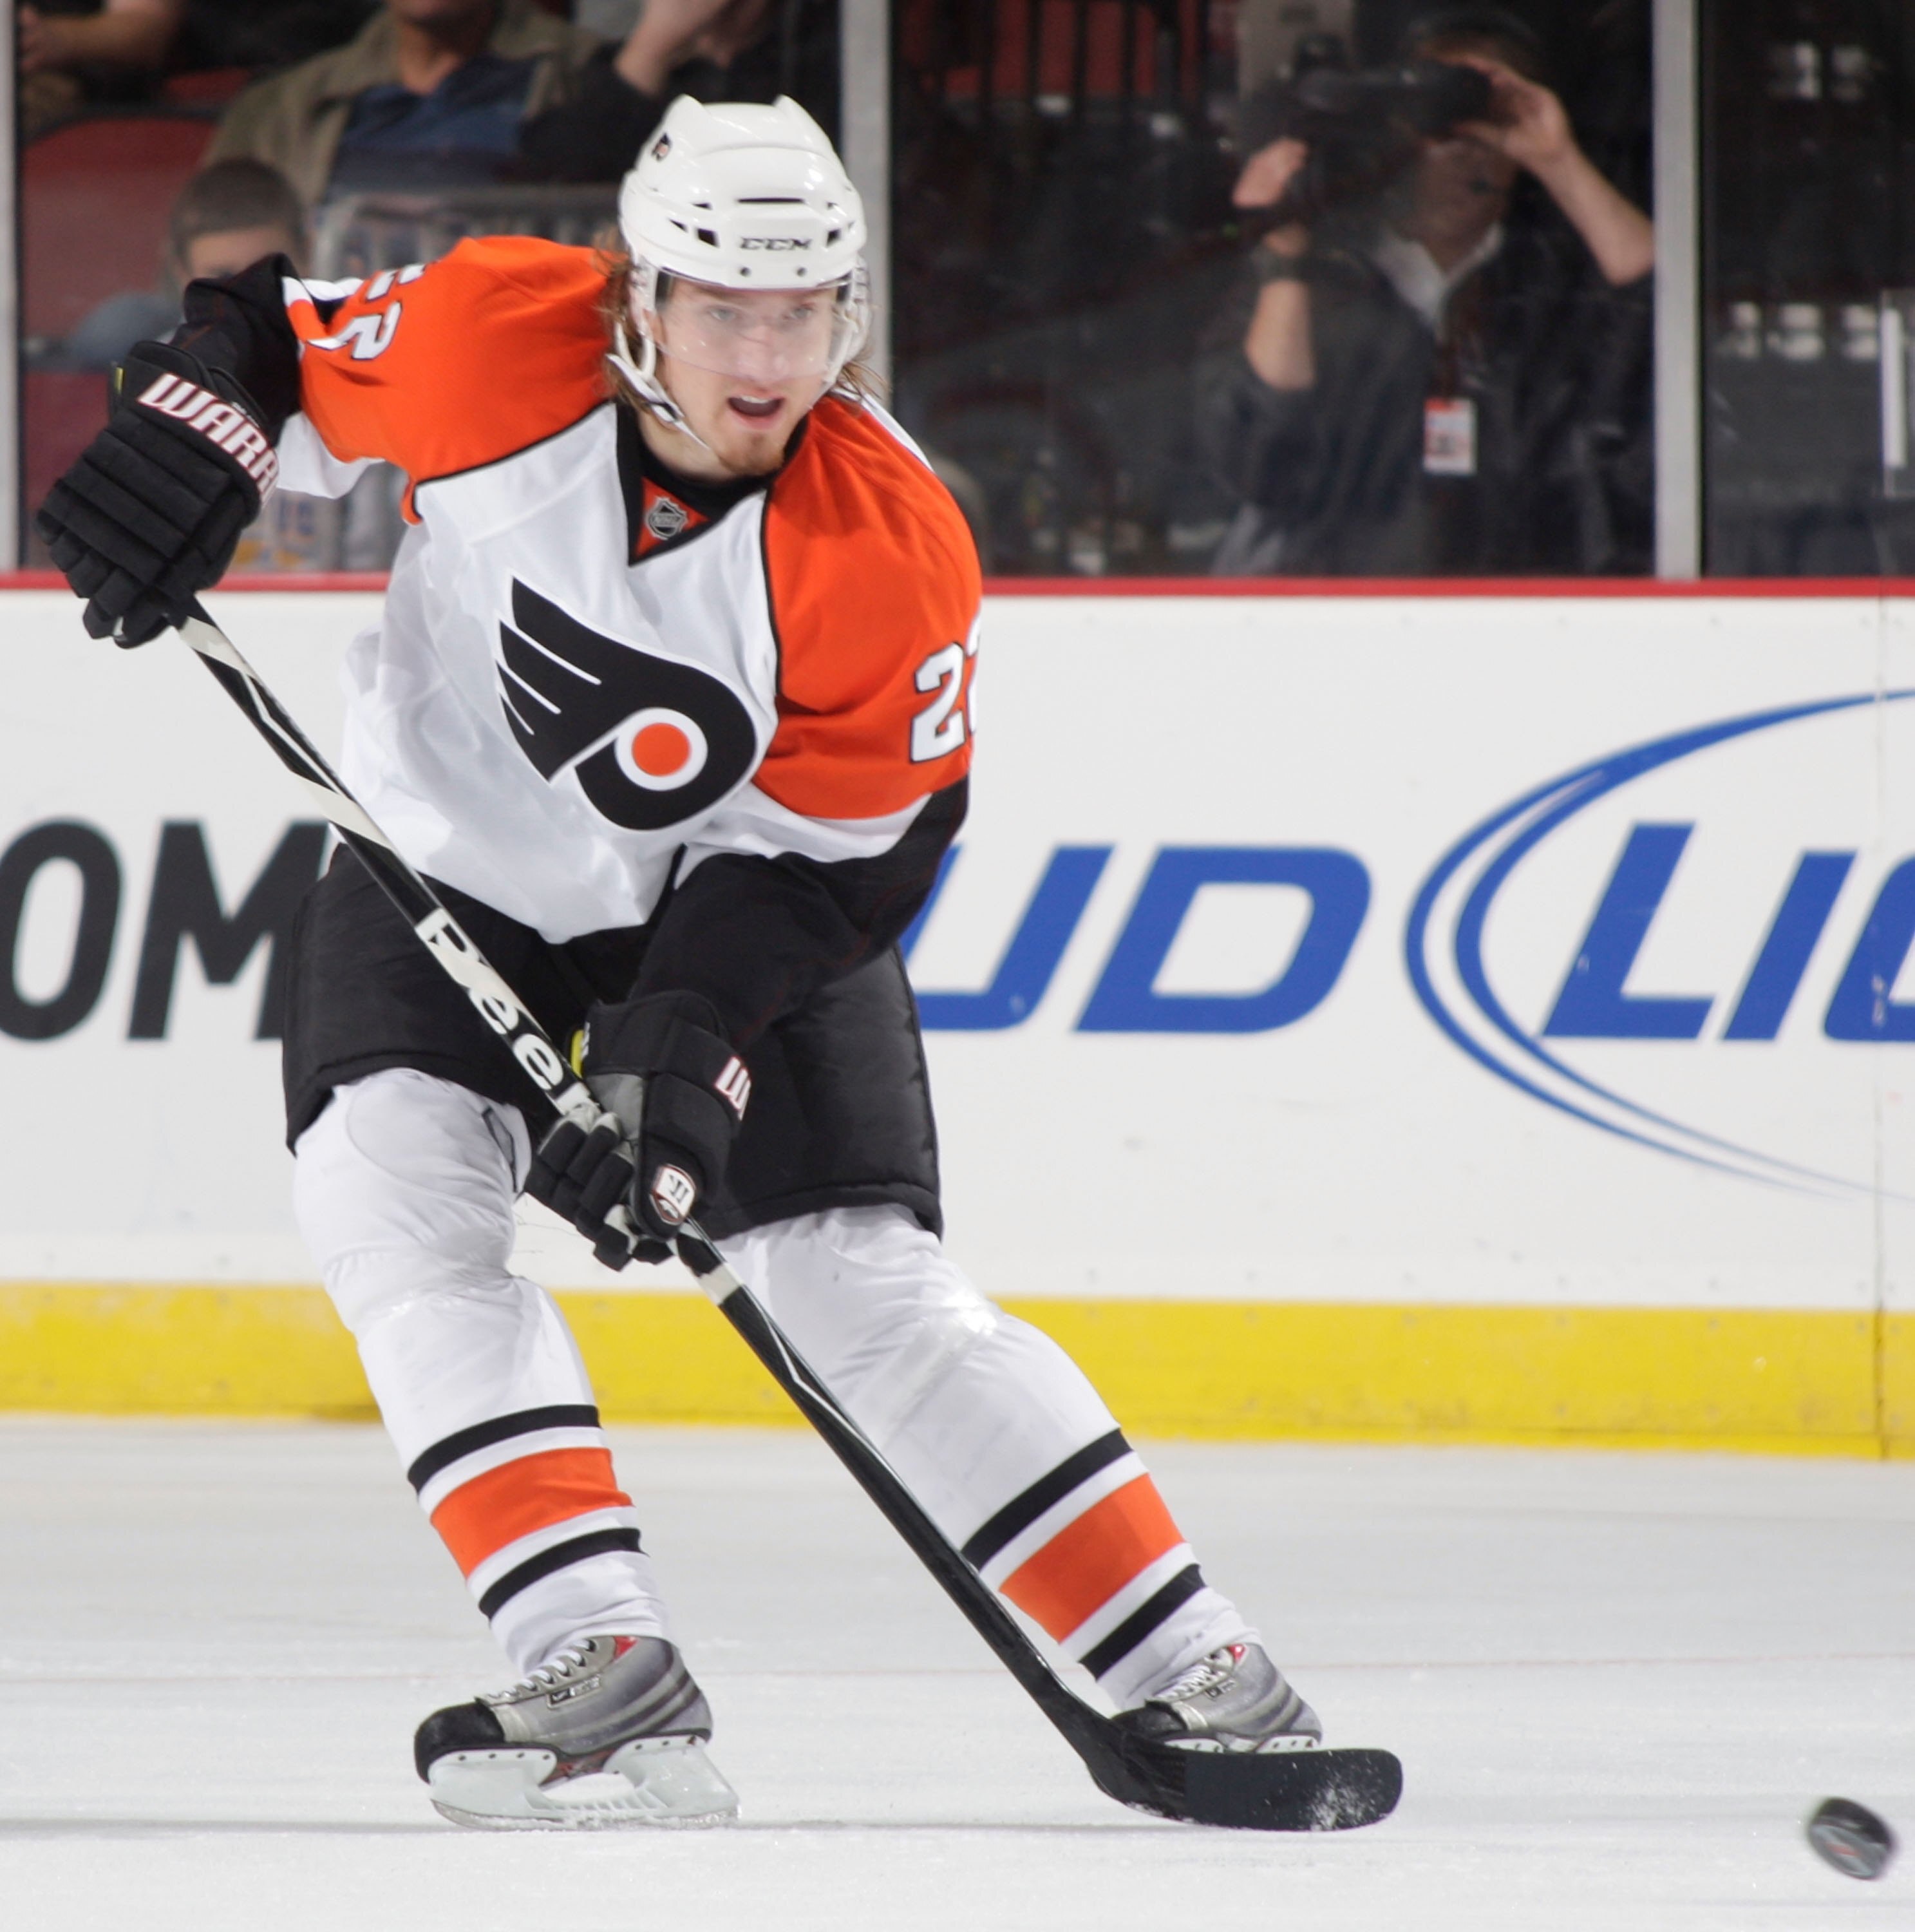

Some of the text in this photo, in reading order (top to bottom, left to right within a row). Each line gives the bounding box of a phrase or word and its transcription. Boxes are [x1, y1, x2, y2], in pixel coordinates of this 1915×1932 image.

[741, 236, 813, 251] CCM
[909, 609, 983, 762] 2
[0, 815, 330, 1043] OM
[898, 842, 1373, 1034] UD
